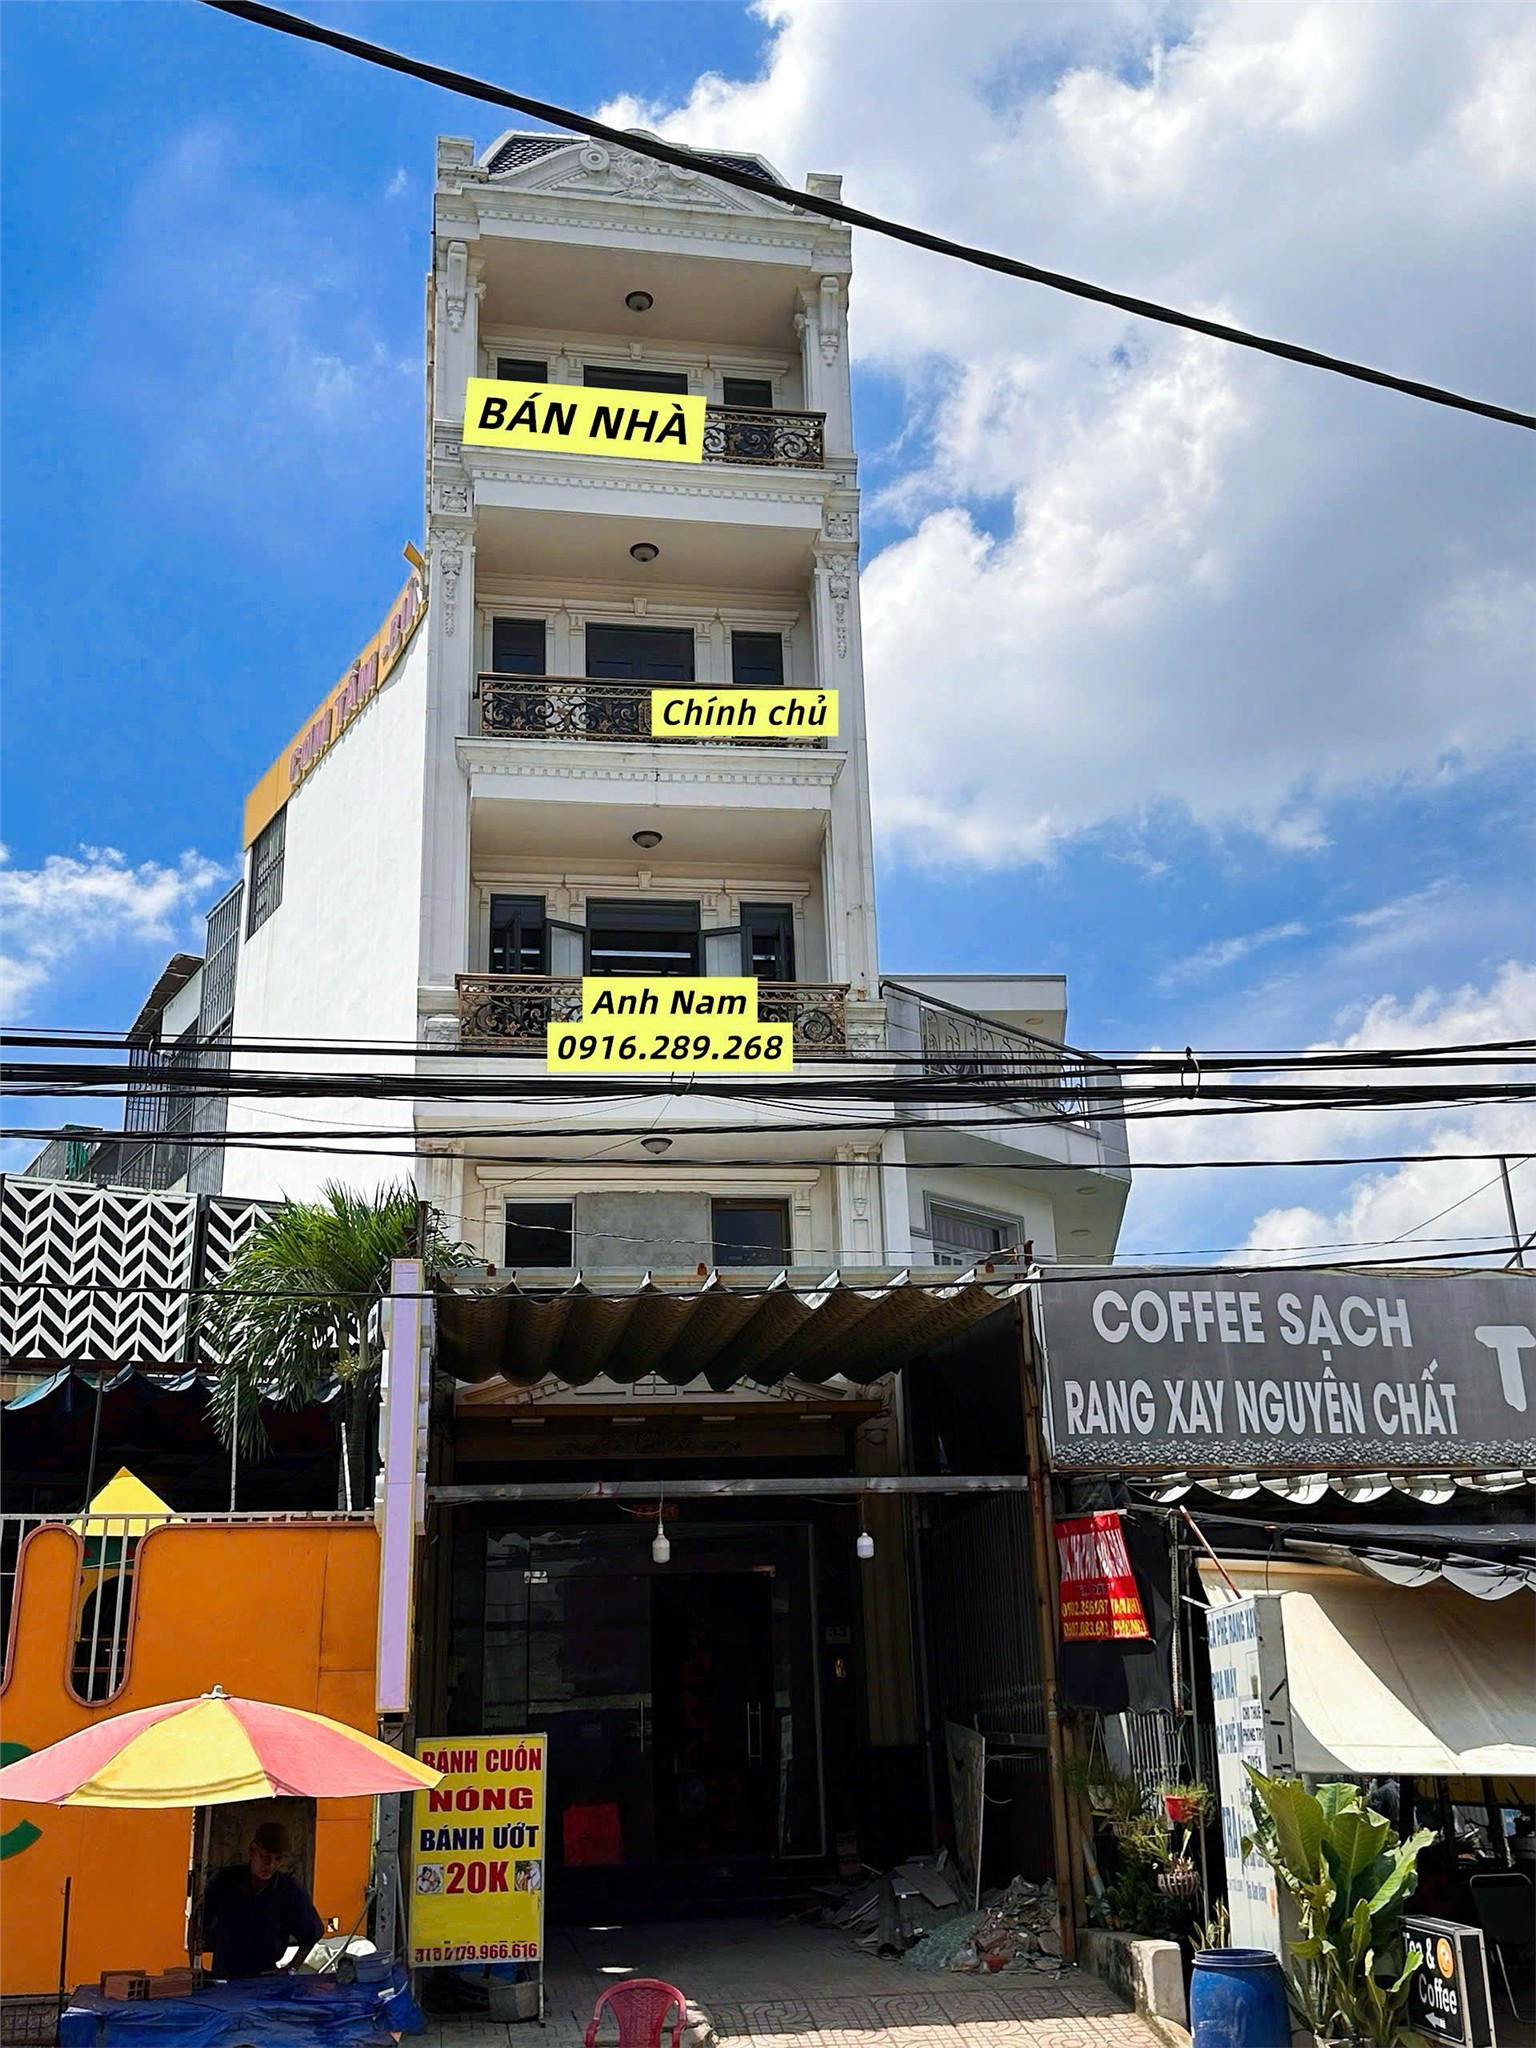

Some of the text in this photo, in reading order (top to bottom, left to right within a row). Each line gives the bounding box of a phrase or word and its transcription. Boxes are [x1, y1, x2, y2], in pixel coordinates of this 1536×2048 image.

[1092, 1289, 1413, 1362] COFFEE SẠCH
[1064, 1379, 1156, 1435] RANG
[1163, 1379, 1224, 1435] XAY
[1373, 1359, 1458, 1435] CHẤT
[422, 1740, 542, 1773] BÁNH CUỐN
[429, 1786, 533, 1813] NÓNG
[420, 1822, 539, 1851] BÁNH ƯỚT
[446, 1860, 509, 1894] 20K
[1425, 1937, 1436, 1969] &
[1418, 1973, 1458, 2015] Coffee
